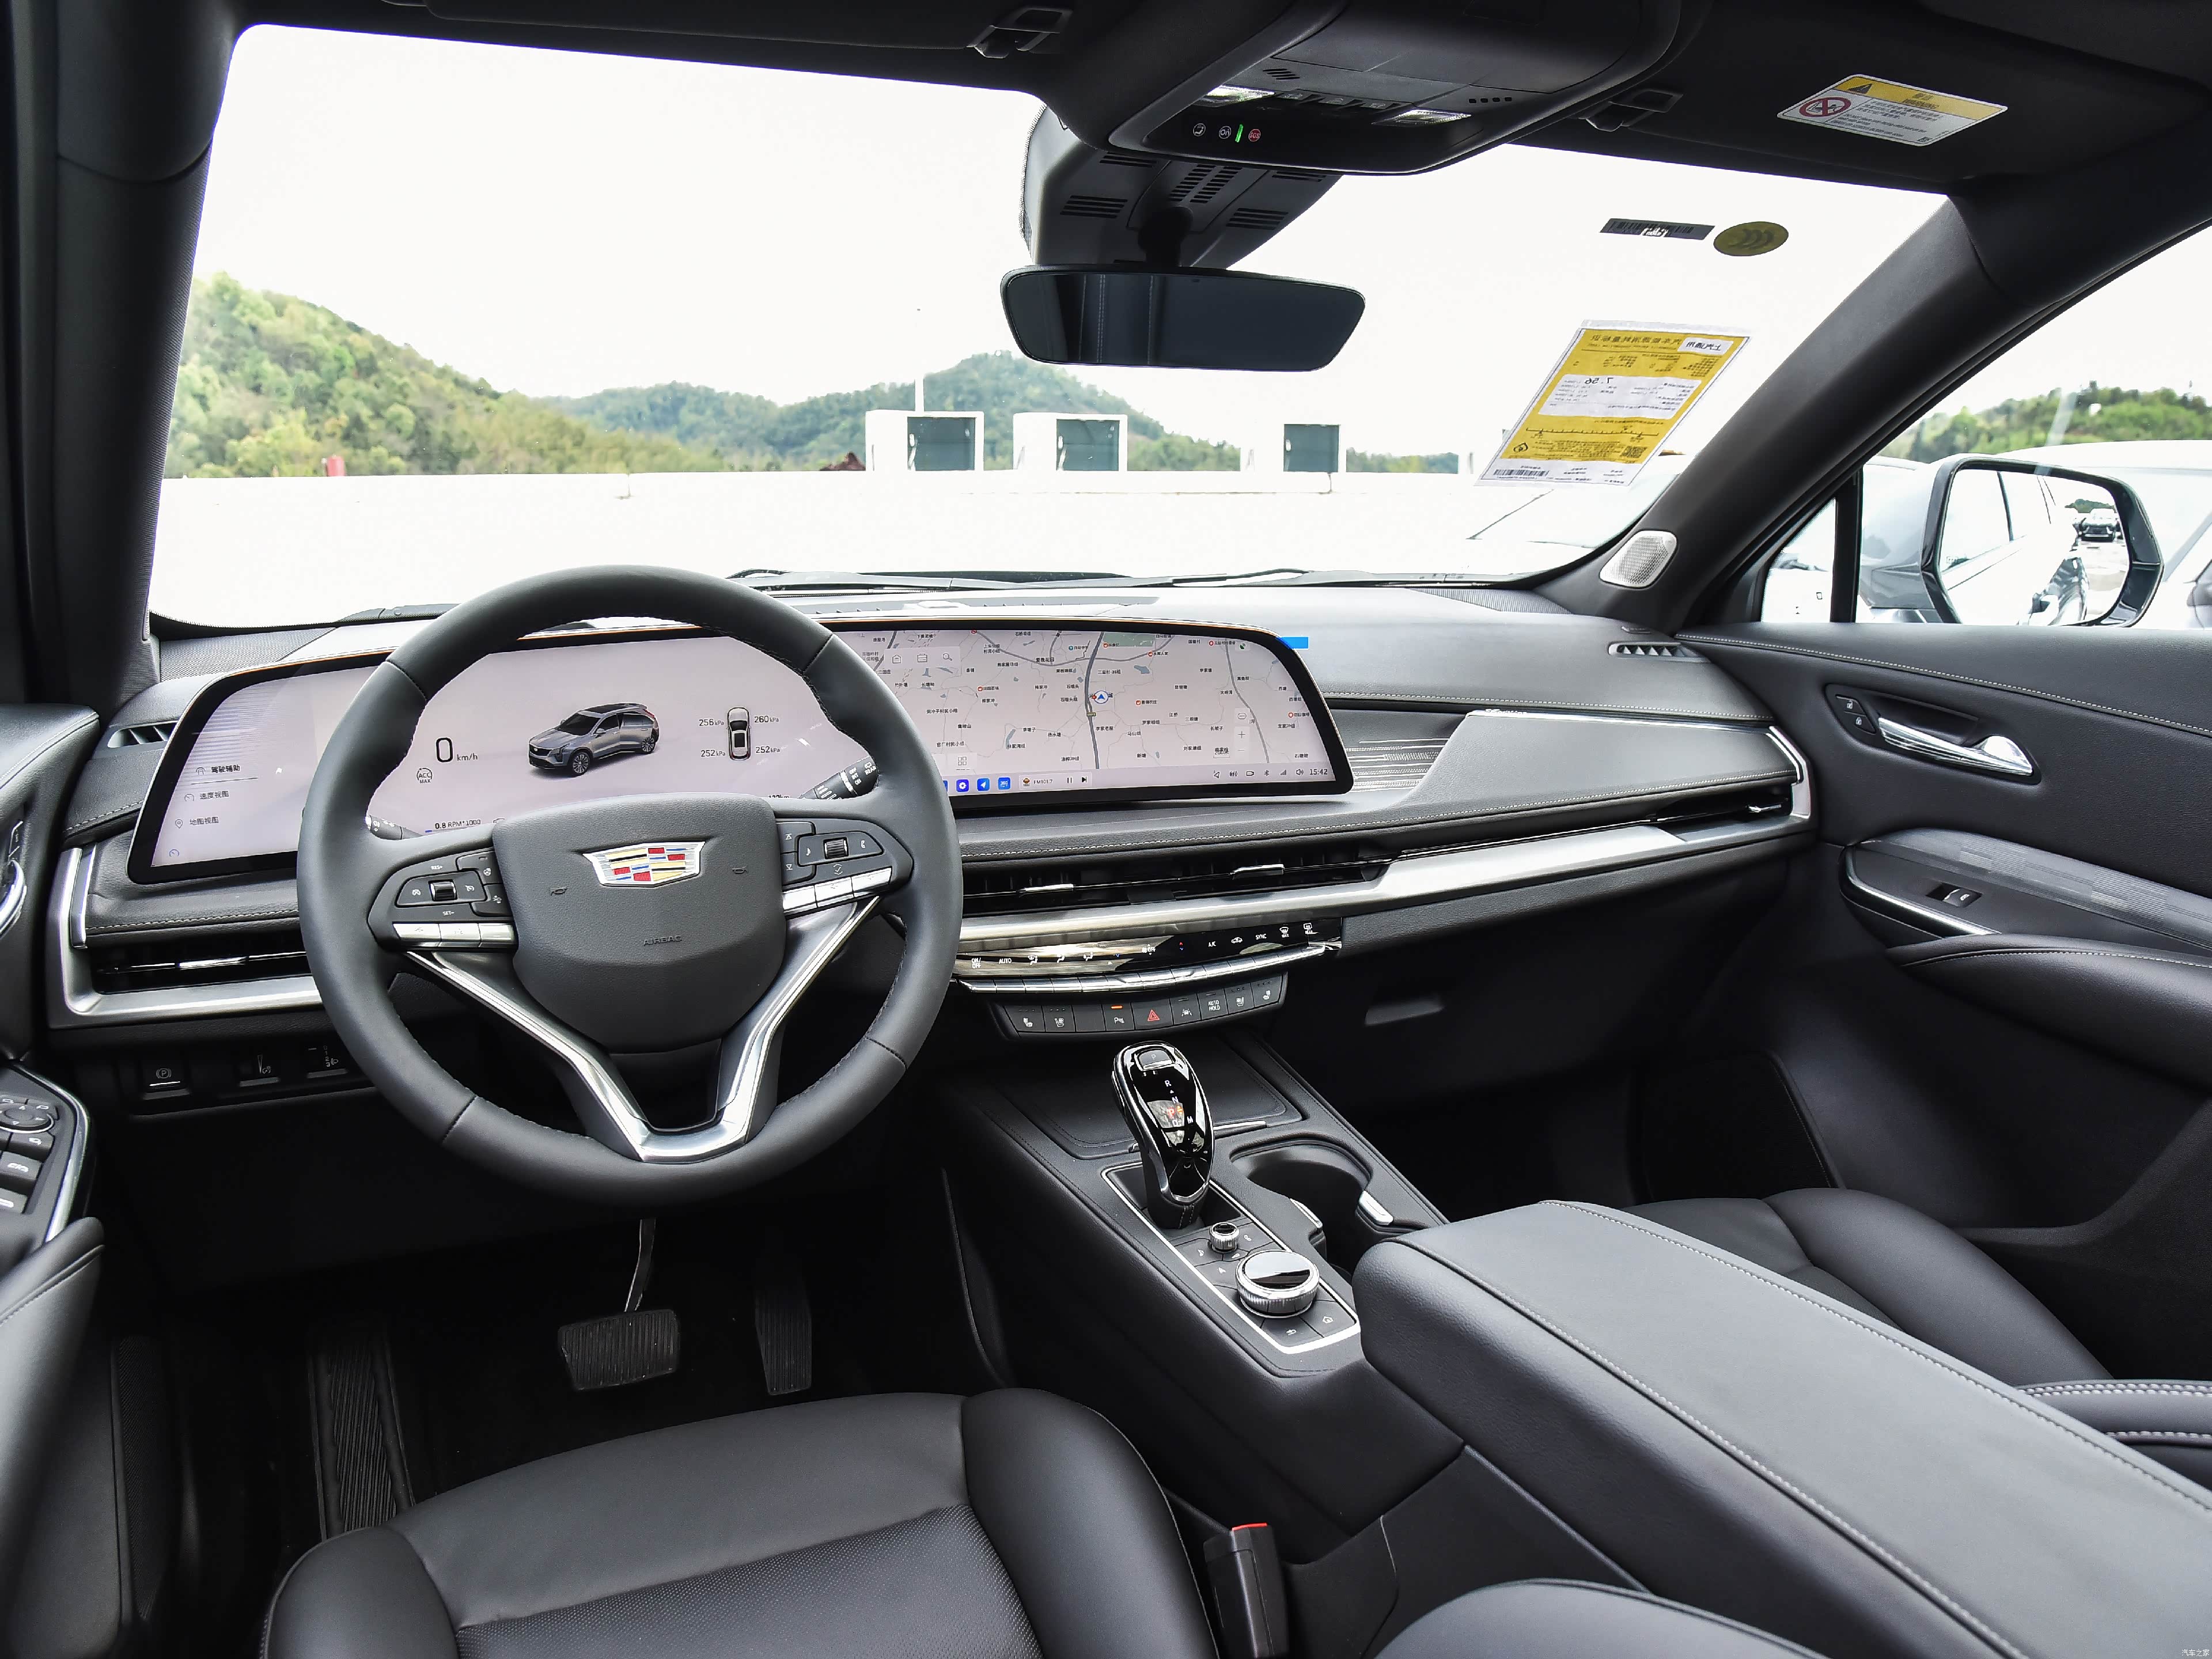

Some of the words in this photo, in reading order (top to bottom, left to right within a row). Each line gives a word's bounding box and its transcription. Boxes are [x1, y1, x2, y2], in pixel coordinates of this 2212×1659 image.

[436, 737, 453, 763] 0
[457, 753, 478, 761] km/h
[211, 764, 240, 773] 驾驶辅助
[865, 766, 876, 775] REAR
[200, 791, 229, 800] 速度视图
[190, 817, 219, 825] 地图视图
[644, 935, 682, 945] AIRBAG
[1187, 1116, 1194, 1124] M
